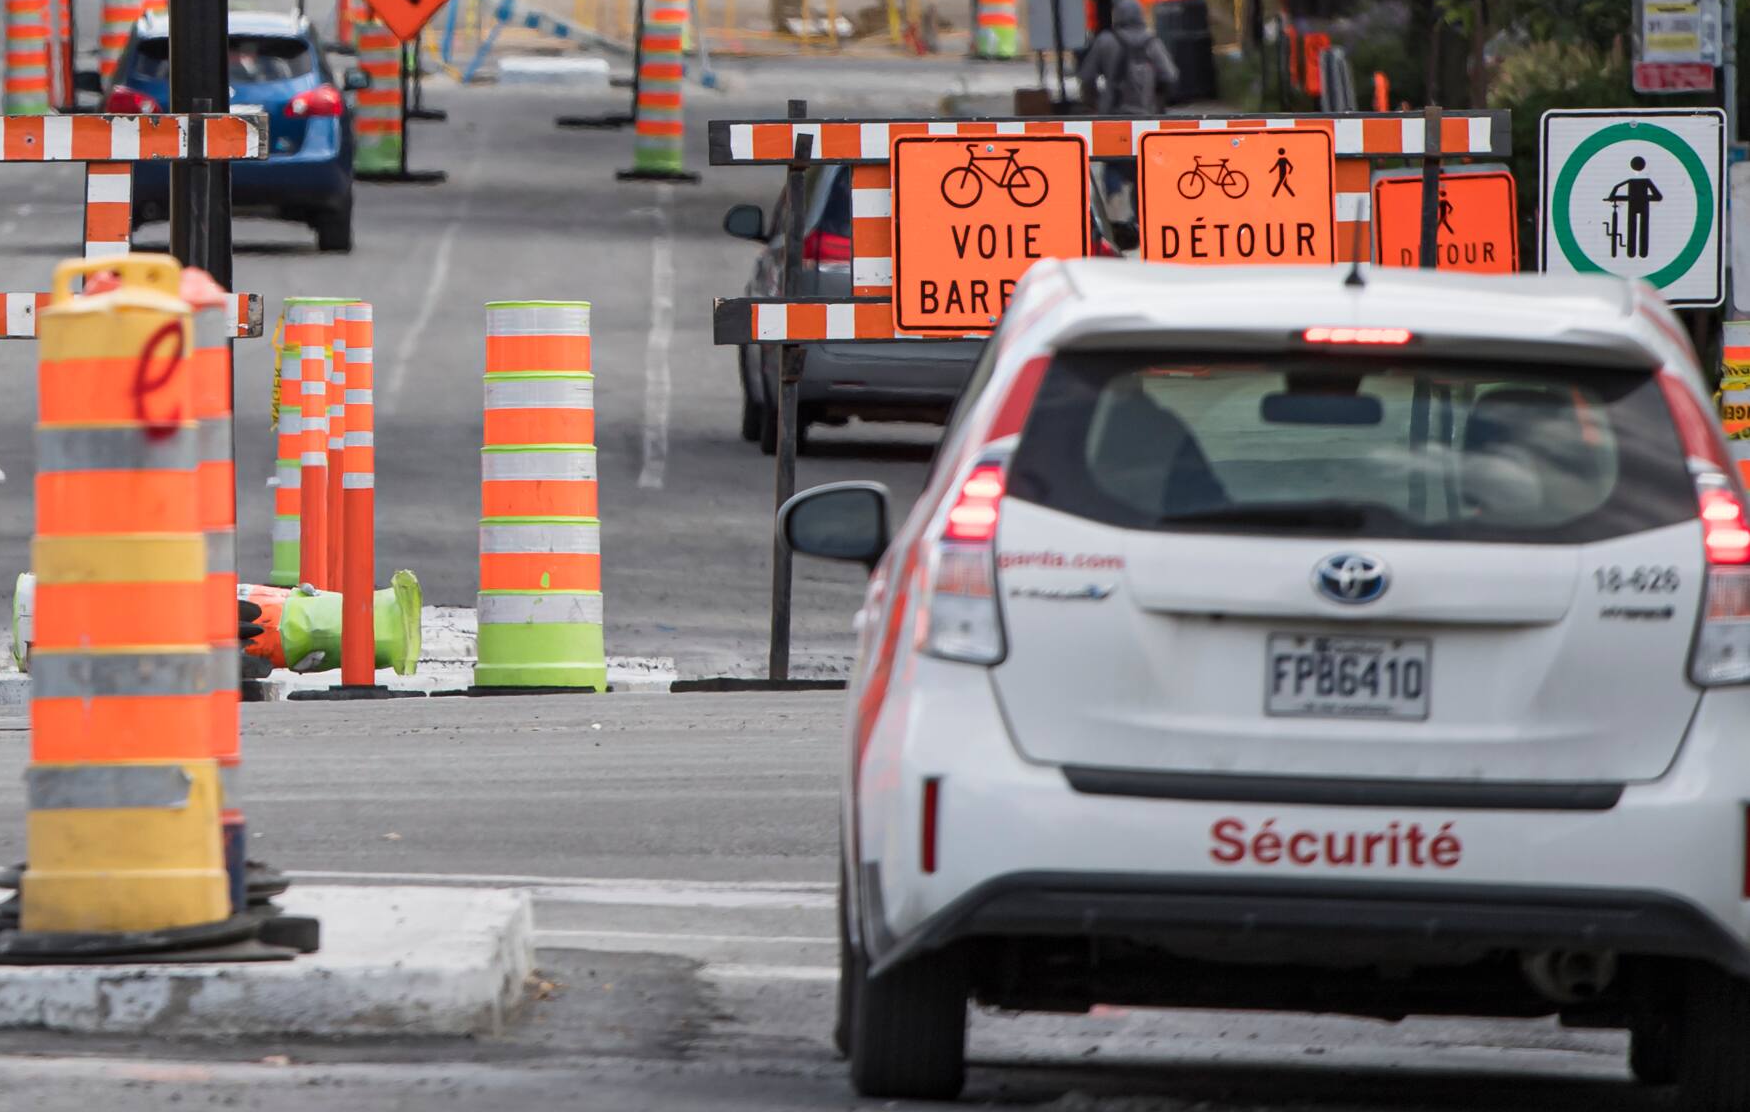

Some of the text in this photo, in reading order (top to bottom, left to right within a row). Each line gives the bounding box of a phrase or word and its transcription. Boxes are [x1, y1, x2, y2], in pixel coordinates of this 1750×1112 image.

[951, 224, 1041, 259] VOIE
[1161, 217, 1316, 258] DÉTOUR
[1401, 242, 1495, 267] DTOUR
[1209, 818, 1462, 867] Sécurité
